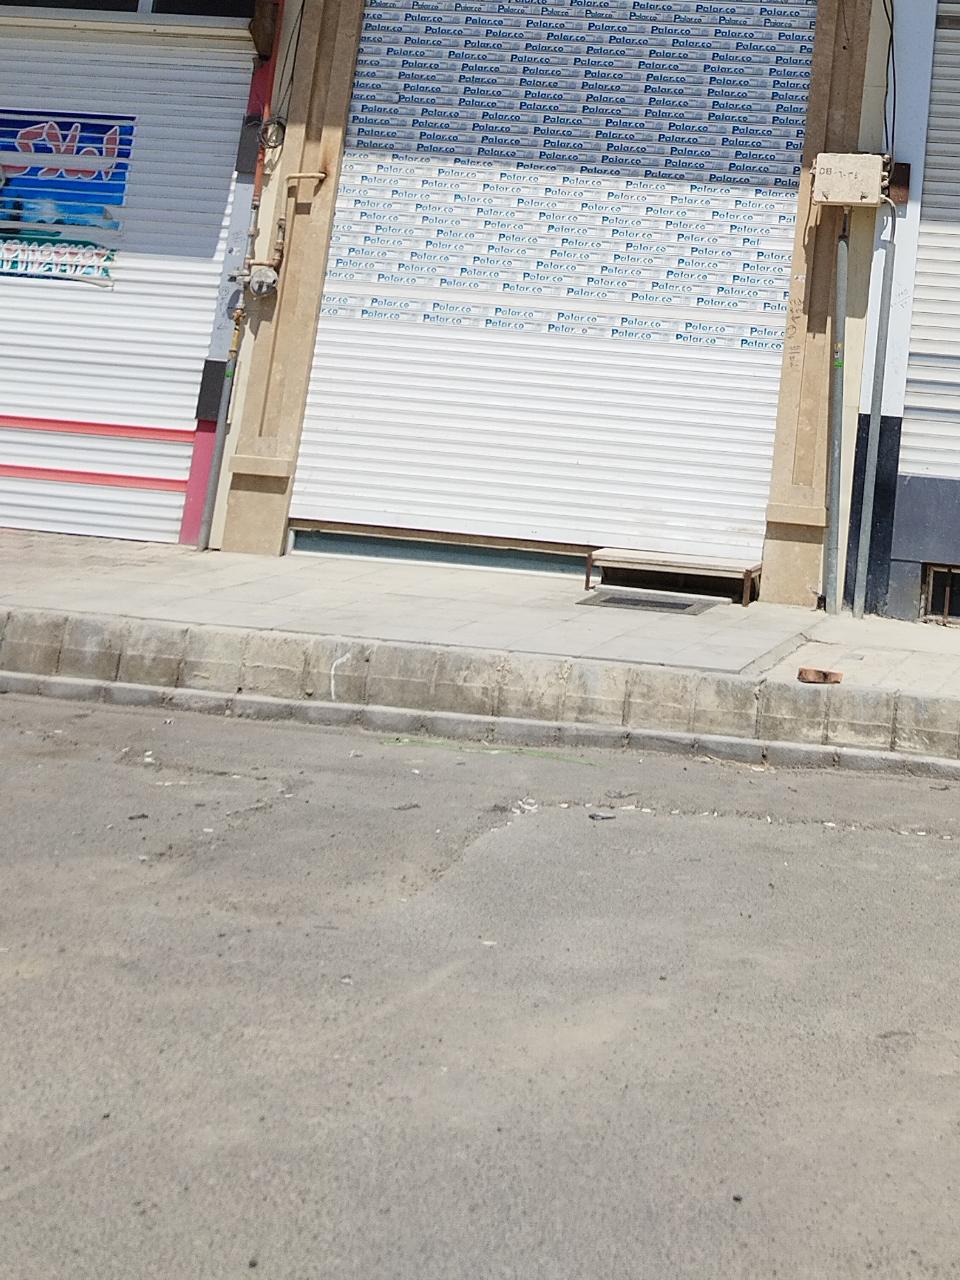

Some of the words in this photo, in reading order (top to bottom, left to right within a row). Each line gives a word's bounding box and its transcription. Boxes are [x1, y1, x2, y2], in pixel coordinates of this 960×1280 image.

[633, 1, 672, 11] Palar.co
[696, 4, 736, 14] Palar.co
[760, 7, 800, 17] Palar.co
[364, 23, 404, 32] Palar.co
[424, 26, 464, 36] Palar.co
[485, 29, 524, 39] Palar.co
[546, 32, 586, 42] Palar.co
[609, 36, 648, 45] Palar.co
[672, 39, 712, 48] Palar.co
[736, 42, 776, 52] Palar.co
[404, 13, 444, 23] Palar.co
[464, 16, 504, 26] Palar.co
[526, 19, 565, 29] Palar.co
[588, 22, 628, 32] Palar.co
[651, 26, 690, 36] Palar.co
[714, 29, 754, 38] Palar.co
[386, 47, 426, 57] Palar.co
[448, 50, 488, 60] Palar.co
[510, 54, 550, 64] Palar.co
[574, 58, 614, 67] Palar.co
[638, 61, 678, 70] Palar.co
[404, 36, 443, 46] Palar.co
[464, 40, 503, 49] Palar.co
[524, 43, 564, 52] Palar.co
[586, 46, 626, 56] Palar.co
[649, 49, 688, 59] Palar.co
[712, 52, 752, 62] Palar.co
[398, 71, 437, 81] Palar.co
[458, 74, 498, 84] Palar.co
[519, 78, 559, 88] Palar.co
[581, 82, 621, 91] Palar.co
[644, 85, 684, 95] Palar.co
[708, 88, 747, 98] Palar.co
[401, 60, 440, 69] Palar.co
[461, 63, 500, 73] Palar.co
[522, 66, 562, 76] Palar.co
[584, 70, 624, 80] Palar.co
[646, 73, 686, 83] Palar.co
[709, 76, 749, 86] Palar.co
[402, 83, 442, 93] Palar.co
[463, 86, 502, 96] Palar.co
[524, 90, 564, 100] Palar.co
[586, 94, 626, 104] Palar.co
[649, 97, 688, 107] Palar.co
[712, 101, 752, 110] Palar.co
[458, 98, 498, 108] Palar.co
[520, 102, 559, 112] Palar.co
[582, 105, 622, 115] Palar.co
[645, 109, 684, 119] Palar.co
[708, 112, 748, 122] Palar.co
[351, 116, 391, 125] Palar.co
[411, 119, 451, 129] Palar.co
[472, 123, 511, 132] Palar.co
[533, 126, 572, 136] Palar.co
[595, 130, 635, 140] Palar.co
[658, 134, 698, 144] Palar.co
[722, 138, 761, 147] Palar.co
[360, 104, 400, 114] Palar.co
[420, 108, 460, 118] Palar.co
[482, 112, 521, 121] Palar.co
[543, 115, 582, 125] Palar.co
[606, 119, 645, 128] Palar.co
[668, 122, 708, 132] Palar.co
[732, 126, 772, 136] Palar.co
[356, 140, 395, 150] Palar.co
[416, 144, 456, 153] Palar.co
[477, 147, 517, 157] Palar.co
[539, 151, 578, 161] Palar.co
[602, 155, 641, 165] Palar.co
[665, 159, 704, 169] Palar.co
[729, 163, 768, 172] Palar.co
[438, 168, 477, 178] Palar.co
[500, 172, 539, 182] Palar.co
[562, 176, 602, 186] Palar.co
[626, 180, 665, 190] Palar.co
[482, 184, 522, 193] Palar.co
[544, 188, 584, 197] Palar.co
[607, 192, 646, 202] Palar.co
[671, 196, 710, 206] Palar.co
[735, 200, 774, 210] Palar.co
[354, 199, 393, 209] Palar.co
[415, 203, 454, 213] Palar.co
[476, 208, 516, 217] Palar.co
[539, 212, 578, 222] Palar.co
[602, 216, 641, 226] Palar.co
[666, 220, 705, 230] Palar.co
[730, 224, 770, 234] Palar.co
[364, 236, 403, 246] Palar.co
[425, 240, 464, 250] Palar.co
[488, 245, 527, 255] Palar.co
[550, 250, 590, 259] Palar.co
[614, 254, 653, 264] Palar.co
[678, 258, 717, 268] Palar.co
[743, 263, 782, 273] Palar.co
[361, 310, 400, 319] Palar.co
[423, 314, 462, 324] Palar.co
[485, 319, 524, 329] Palar.co
[612, 329, 651, 339] Palar.co
[676, 334, 715, 344] Palar.co
